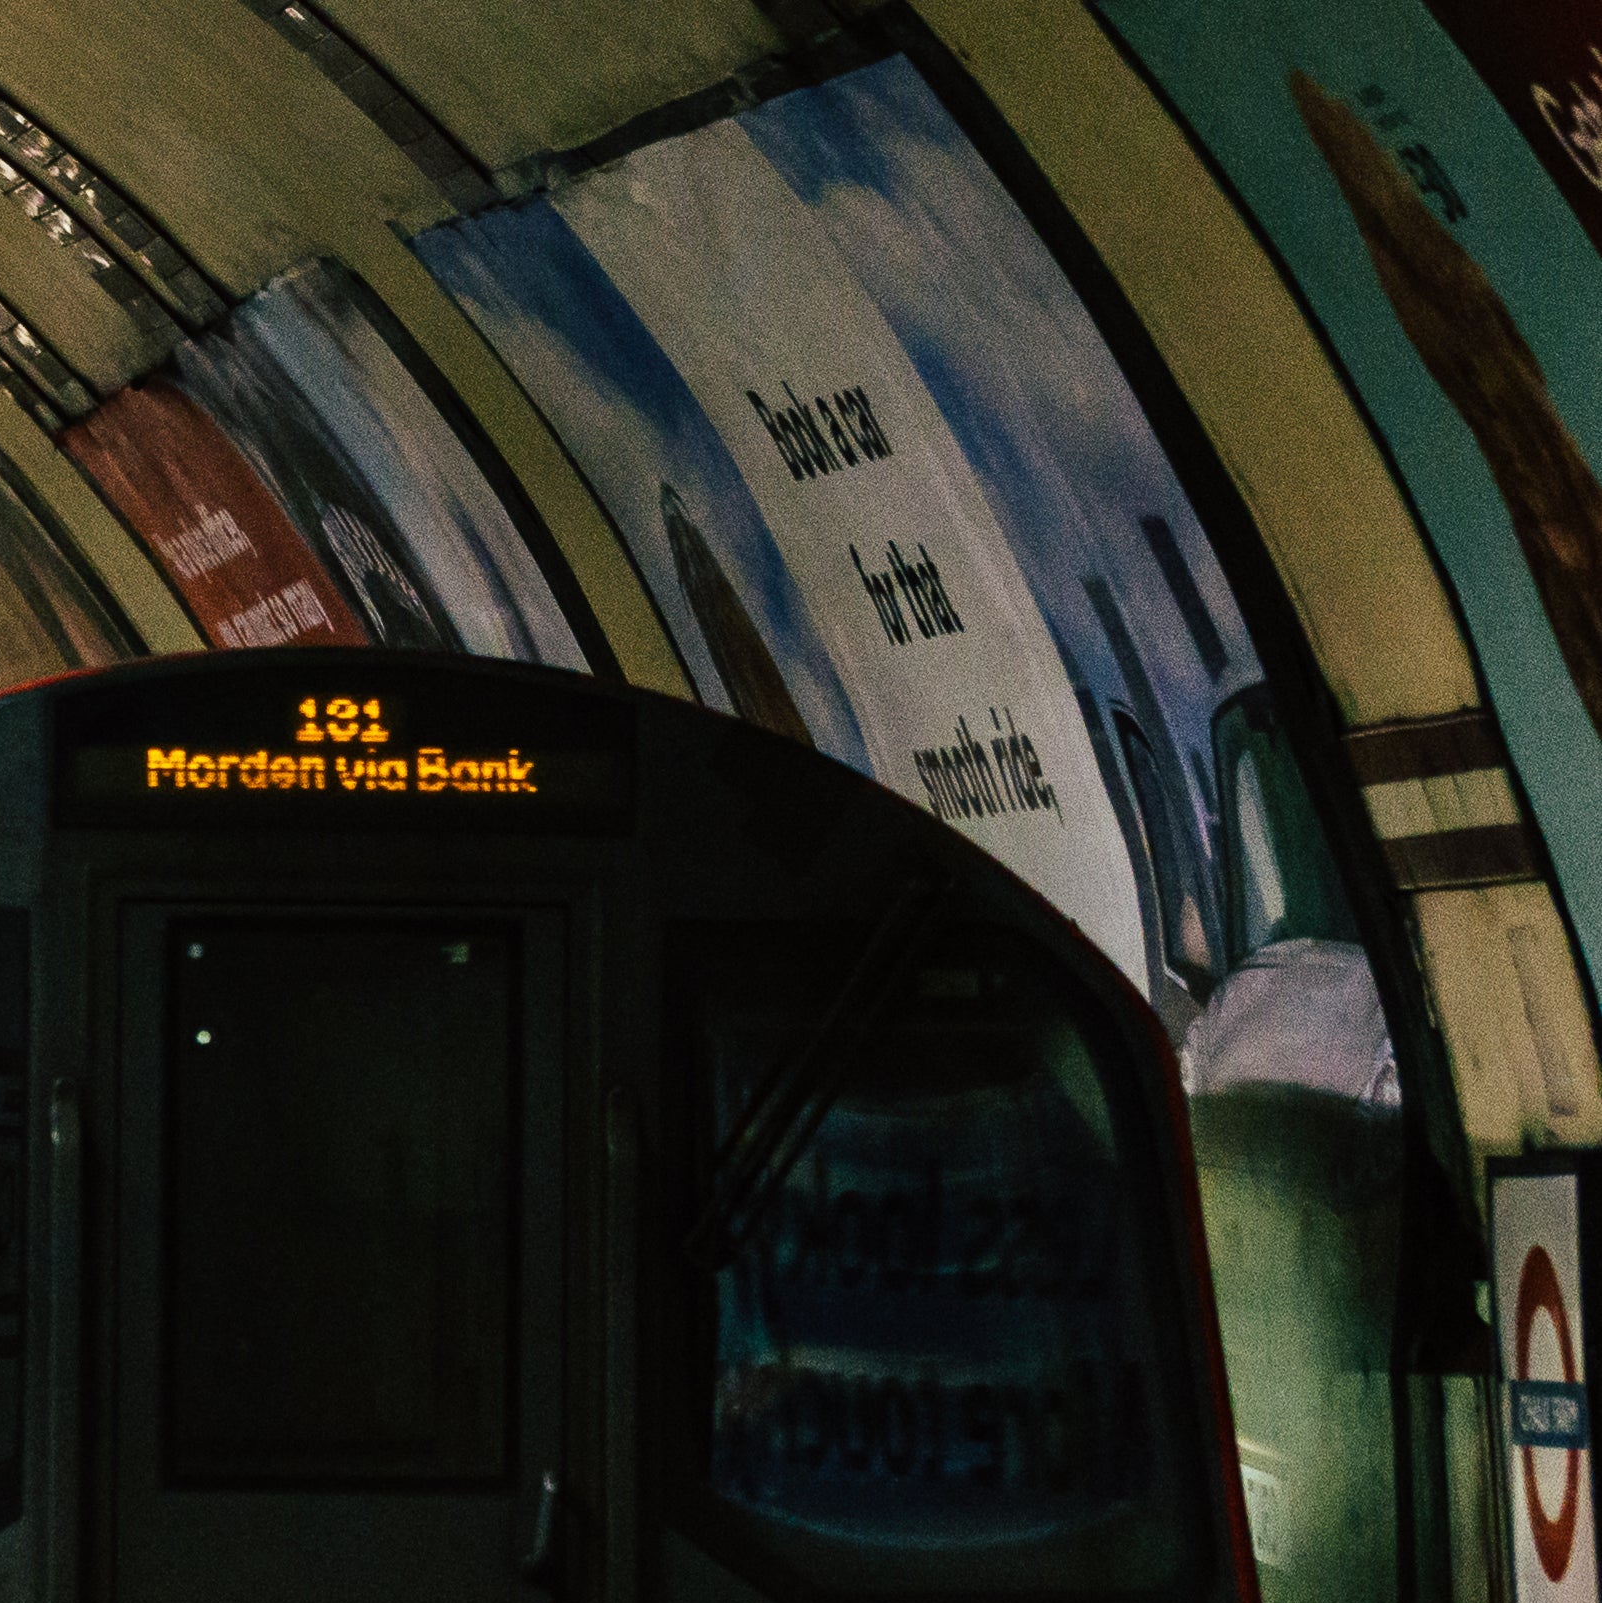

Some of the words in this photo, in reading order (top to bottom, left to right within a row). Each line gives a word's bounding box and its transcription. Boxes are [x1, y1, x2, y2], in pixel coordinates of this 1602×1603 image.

[745, 380, 843, 481] Book
[815, 396, 859, 467] a
[834, 385, 893, 463] car
[886, 540, 965, 640] that
[147, 749, 325, 789] Morden
[335, 748, 407, 791] via
[417, 748, 536, 792] Bank
[913, 715, 1006, 818] smooth
